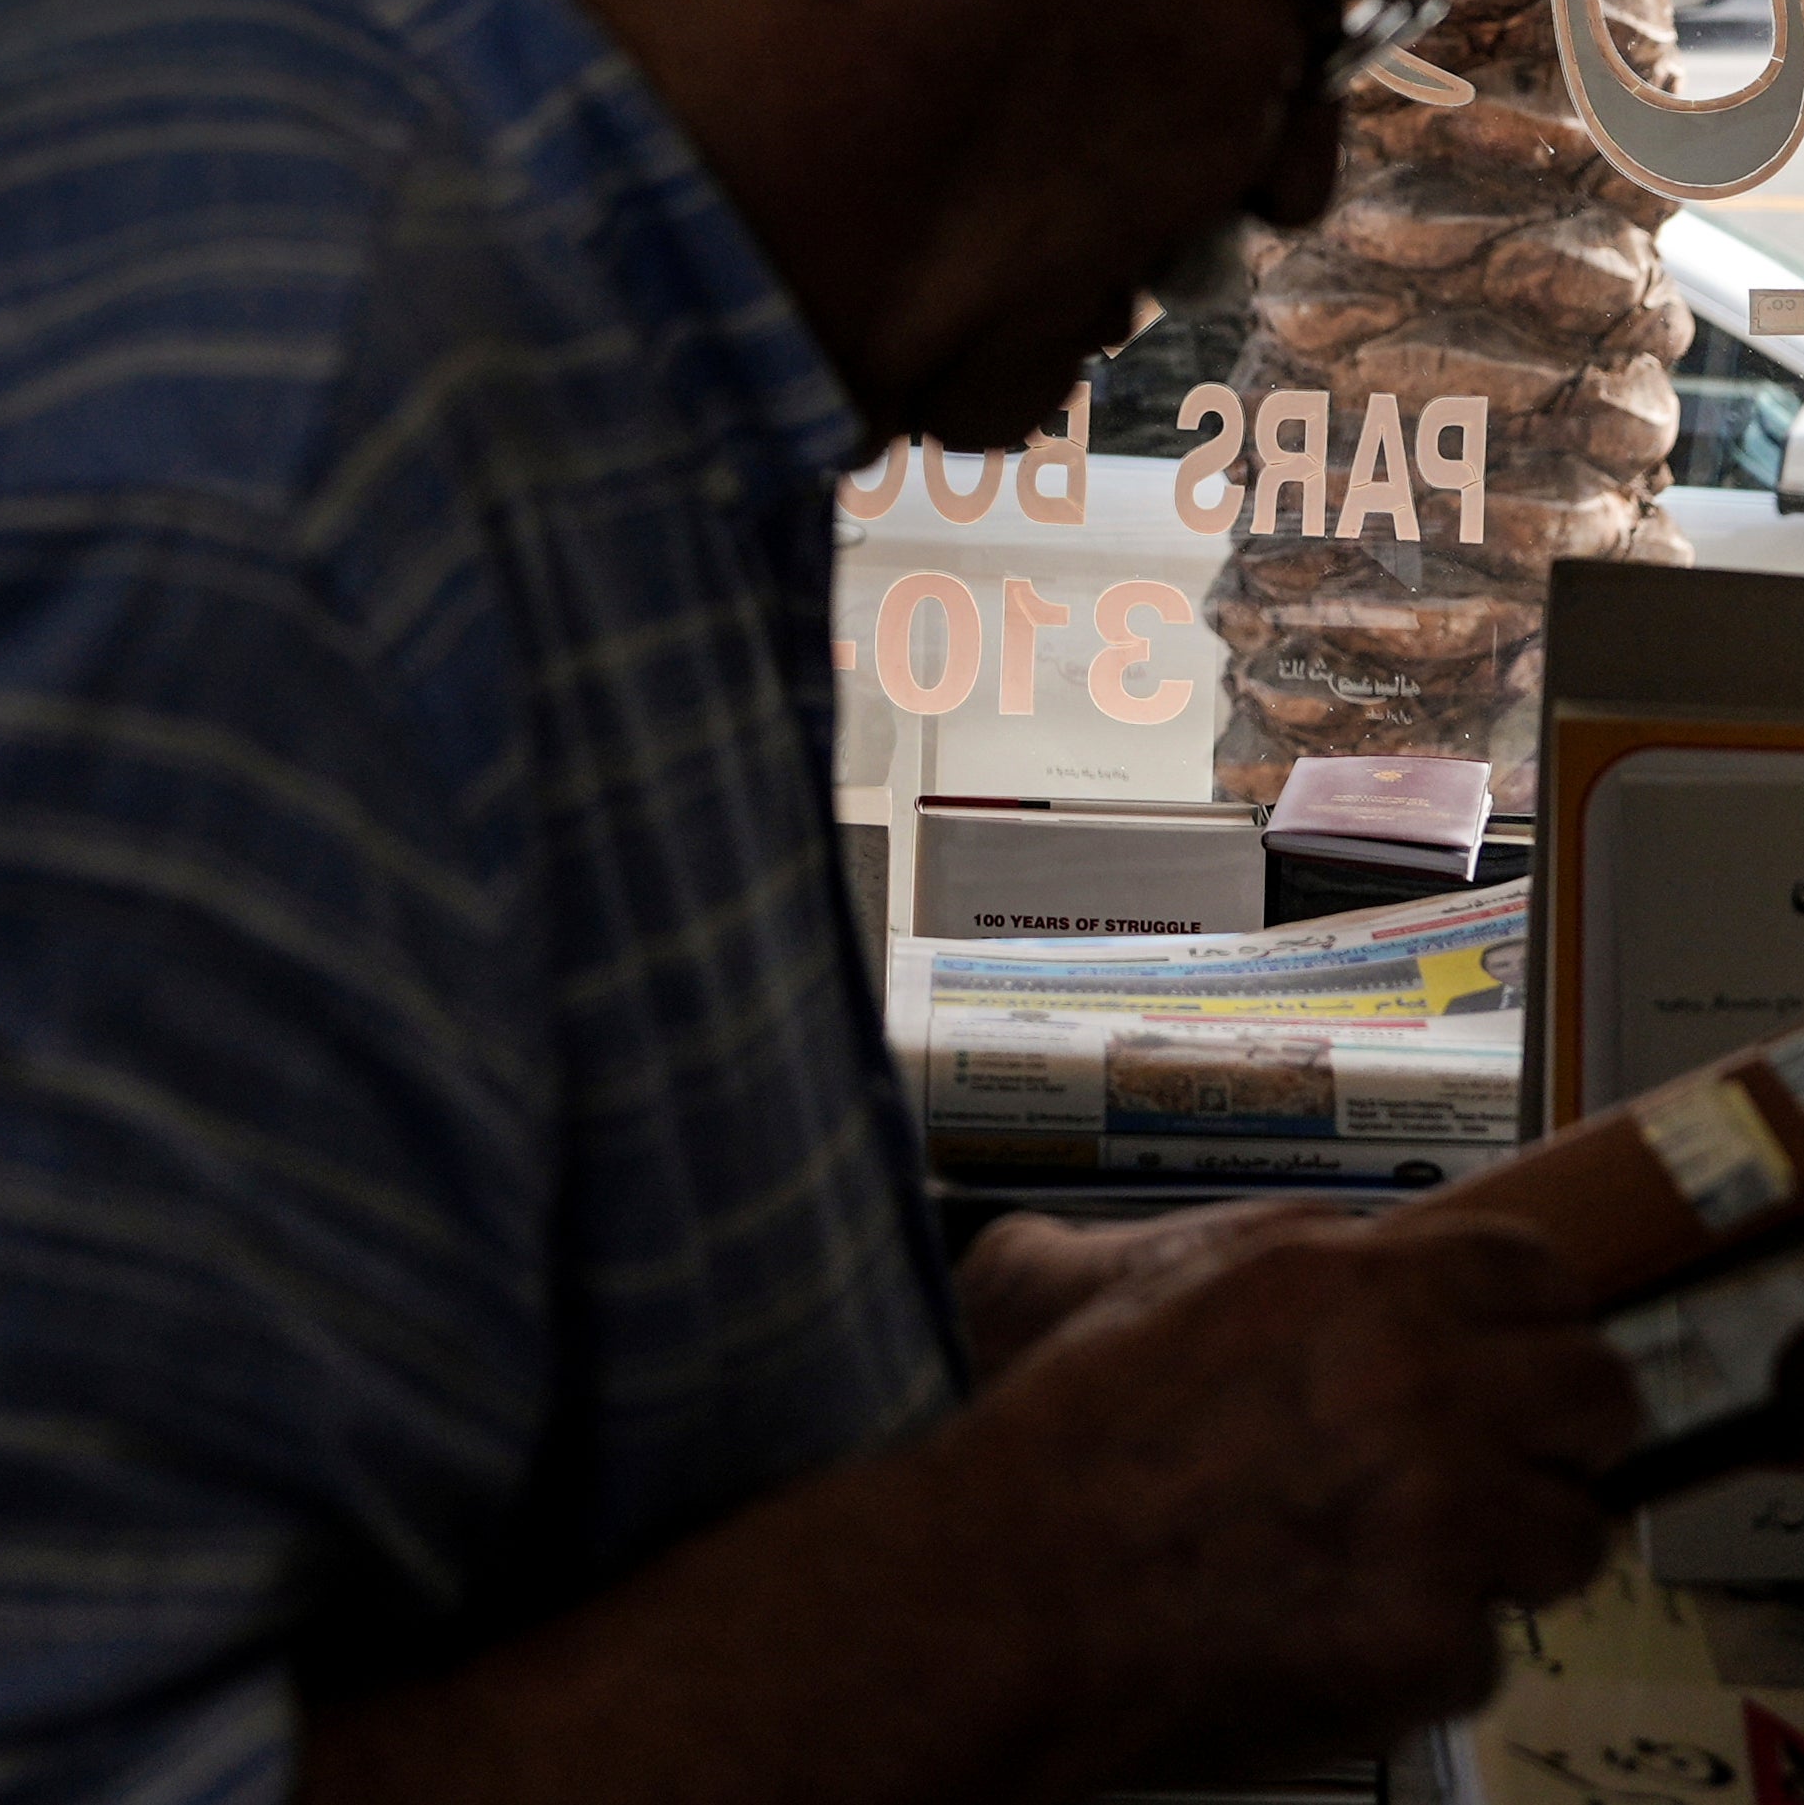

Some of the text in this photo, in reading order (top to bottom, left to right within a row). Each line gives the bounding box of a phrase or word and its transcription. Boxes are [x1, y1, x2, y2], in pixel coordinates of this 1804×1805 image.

[973, 913, 1202, 934] 100 YEARS OF STRUGGLE
